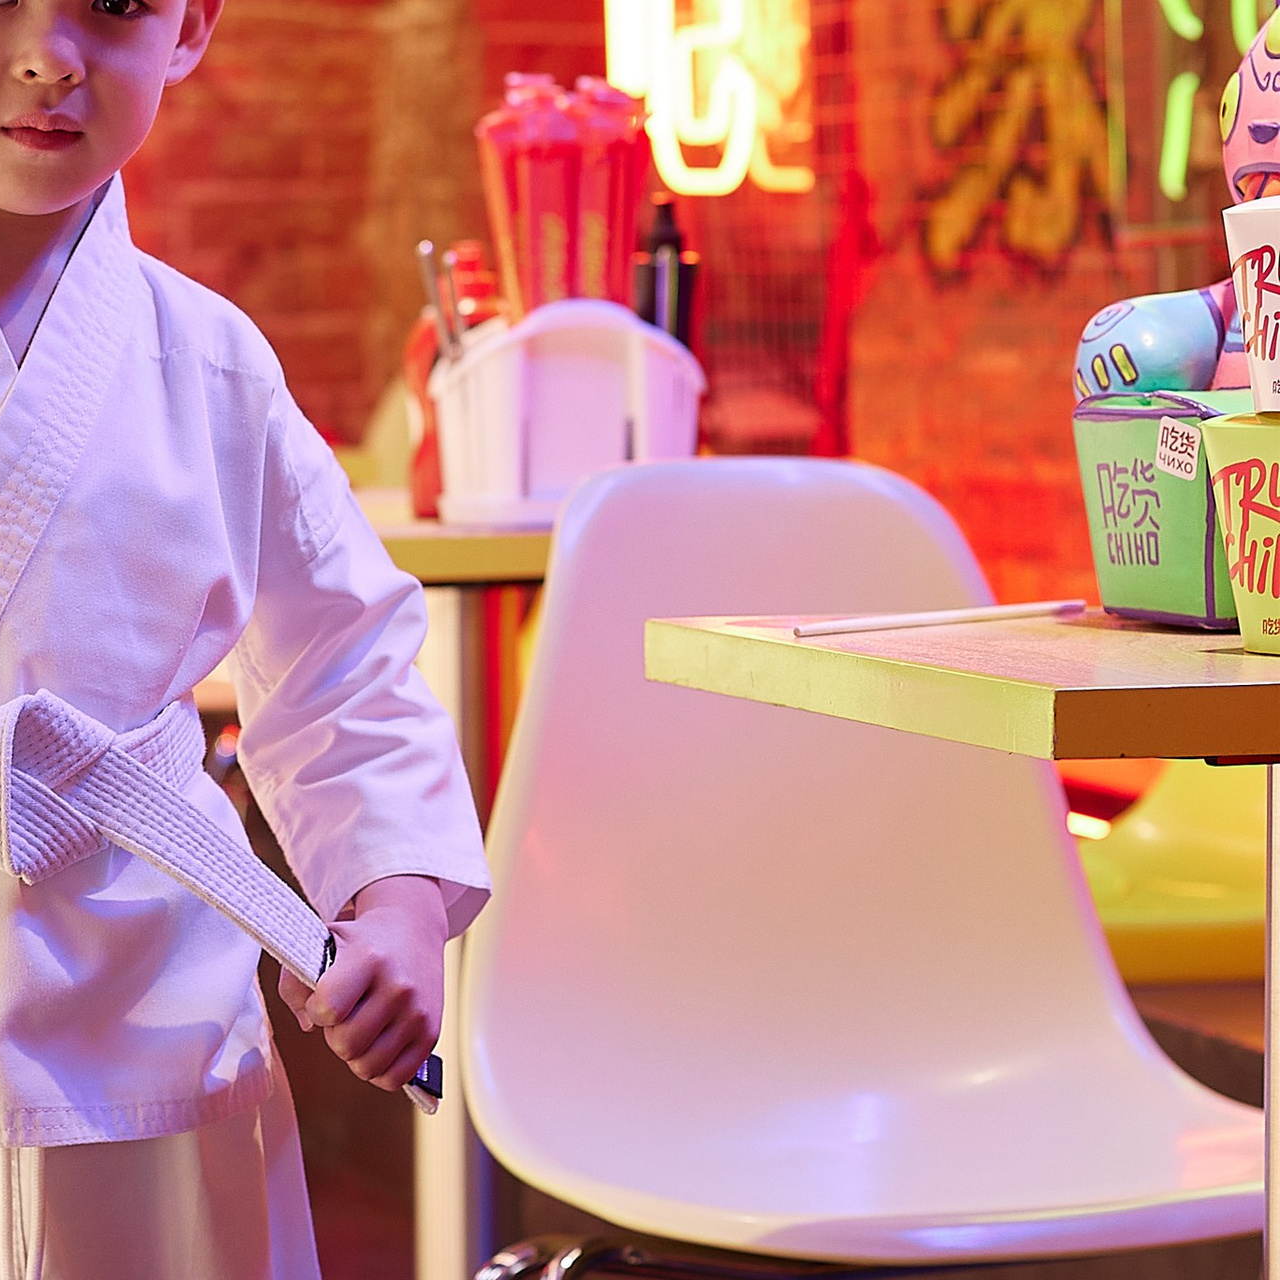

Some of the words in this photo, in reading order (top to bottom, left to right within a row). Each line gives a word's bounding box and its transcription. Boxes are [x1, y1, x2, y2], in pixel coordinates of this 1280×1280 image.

[1232, 245, 1280, 310] TR
[1160, 426, 1195, 459] 吃货
[1097, 458, 1160, 530] 吃货
[1107, 531, 1160, 566] CHIHO
